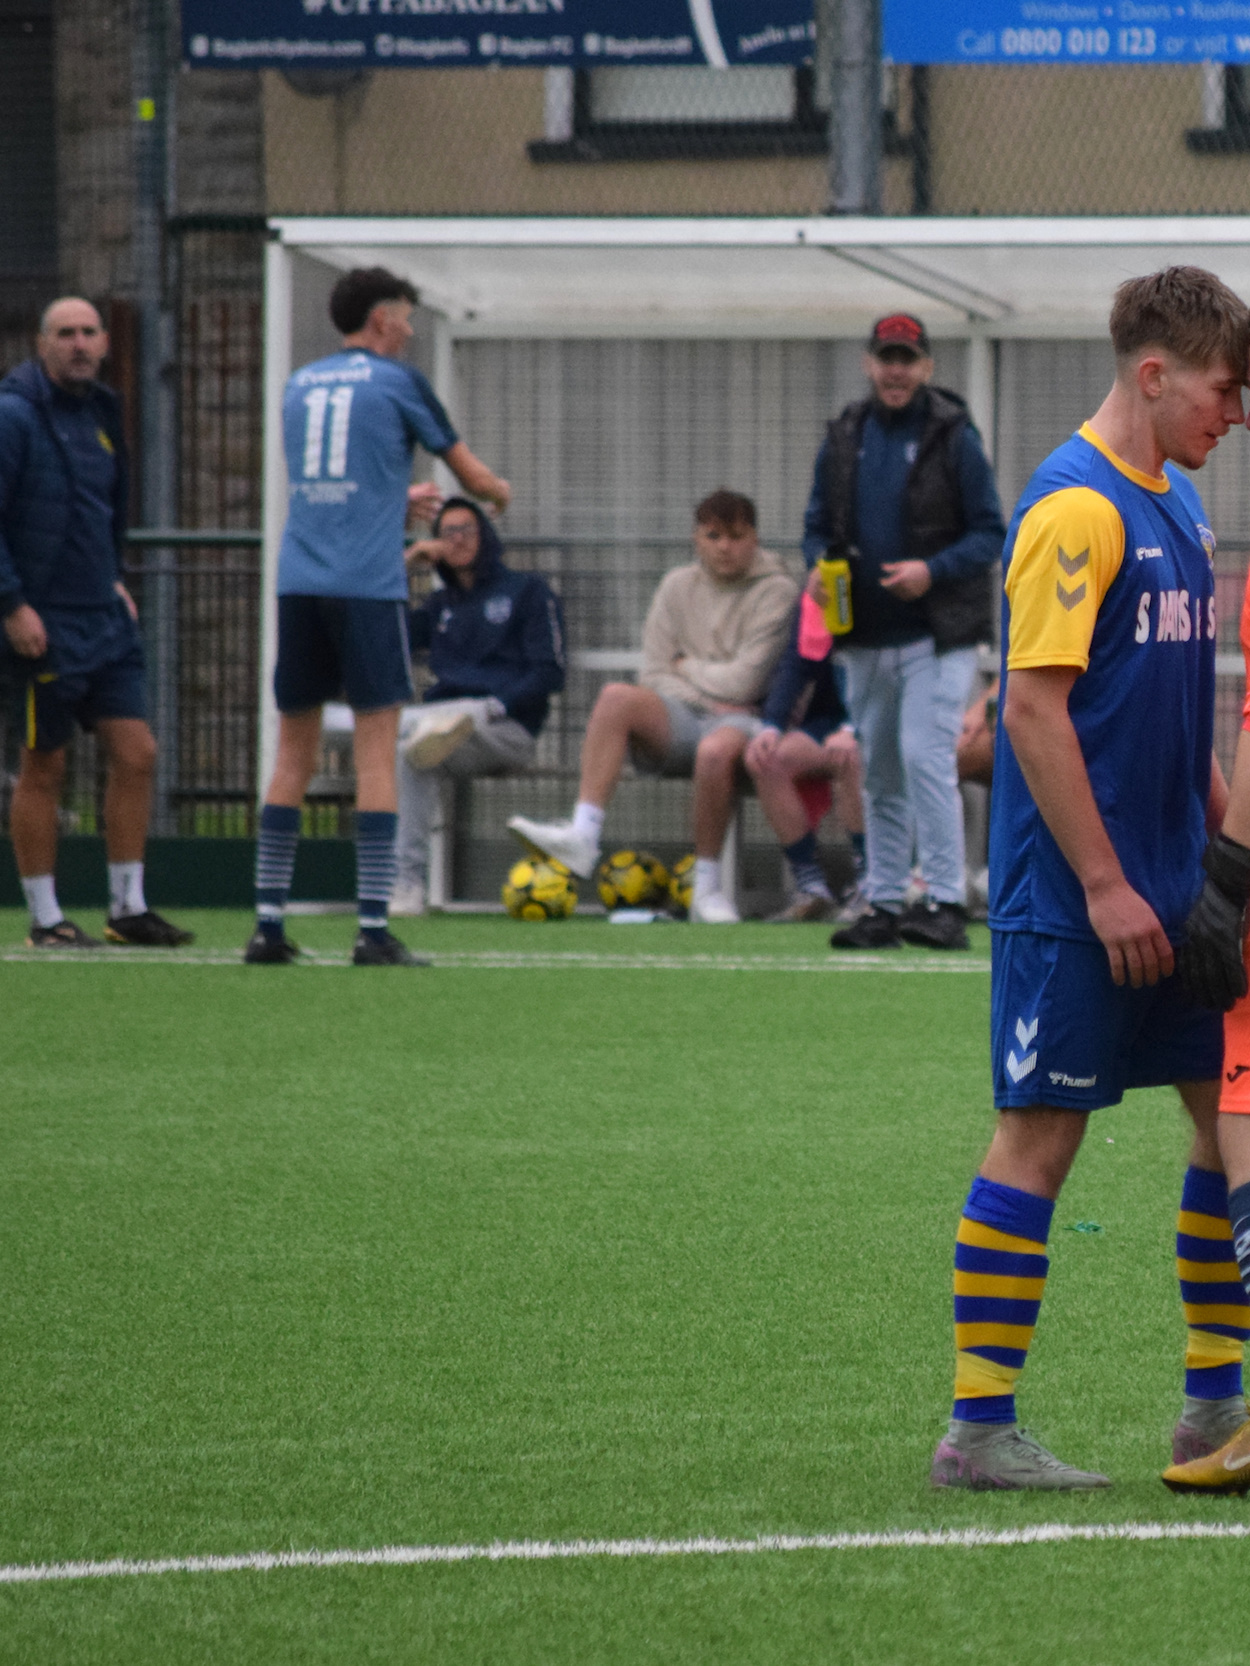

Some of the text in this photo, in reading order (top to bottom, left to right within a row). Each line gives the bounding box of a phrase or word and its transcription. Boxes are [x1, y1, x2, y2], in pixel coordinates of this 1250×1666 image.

[1001, 27, 1062, 56] 0800
[1067, 27, 1110, 56] 010
[1118, 28, 1157, 56] 123
[304, 386, 354, 479] 11
[1135, 592, 1152, 643] S
